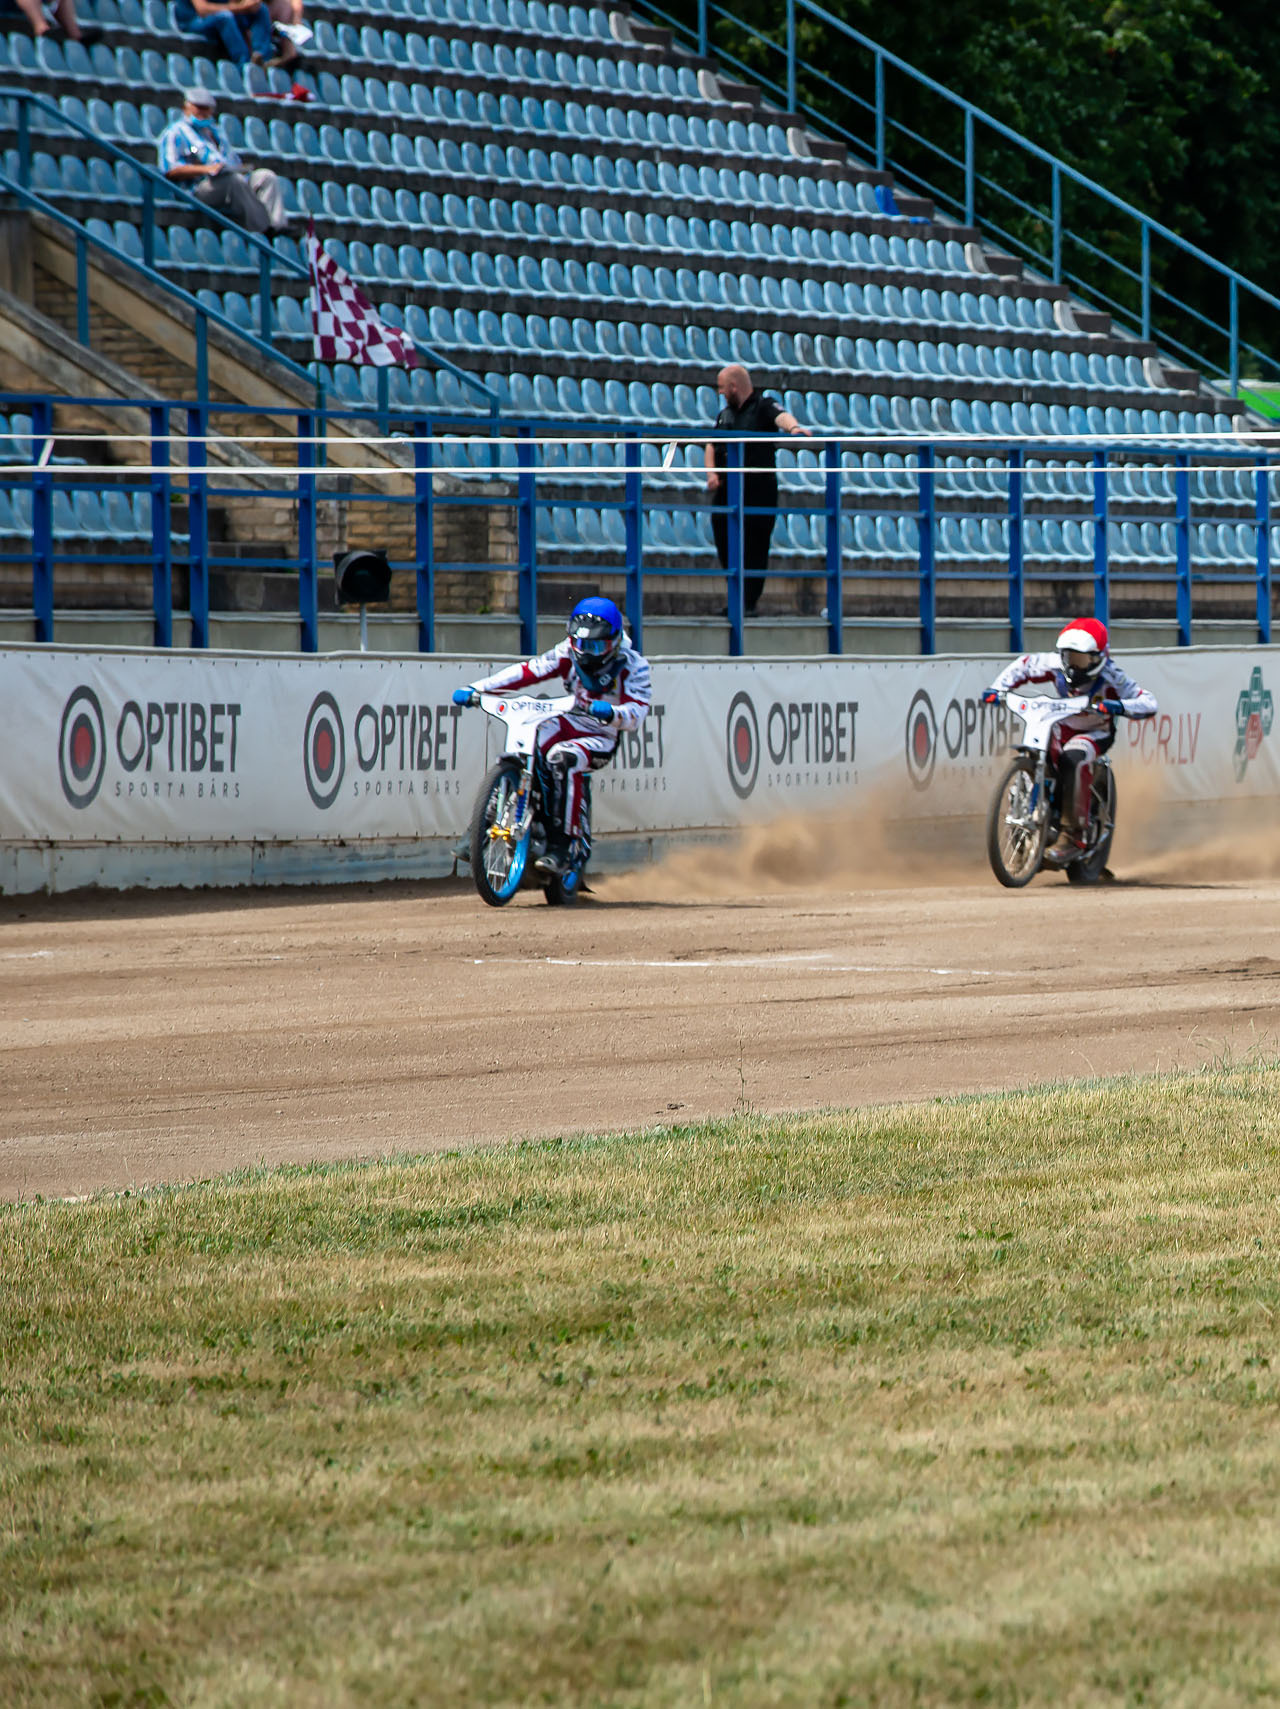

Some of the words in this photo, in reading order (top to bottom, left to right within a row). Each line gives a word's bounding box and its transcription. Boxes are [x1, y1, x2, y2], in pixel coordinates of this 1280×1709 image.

[116, 700, 241, 772] OPTIBET
[511, 701, 553, 712] OPTIBET
[613, 704, 665, 769] IBET
[767, 702, 858, 765] OPTIBET
[943, 698, 1020, 758] OPTIBE
[354, 704, 462, 772] OPTIBET
[115, 781, 185, 798] SPORTA
[353, 781, 414, 797] SPORTA
